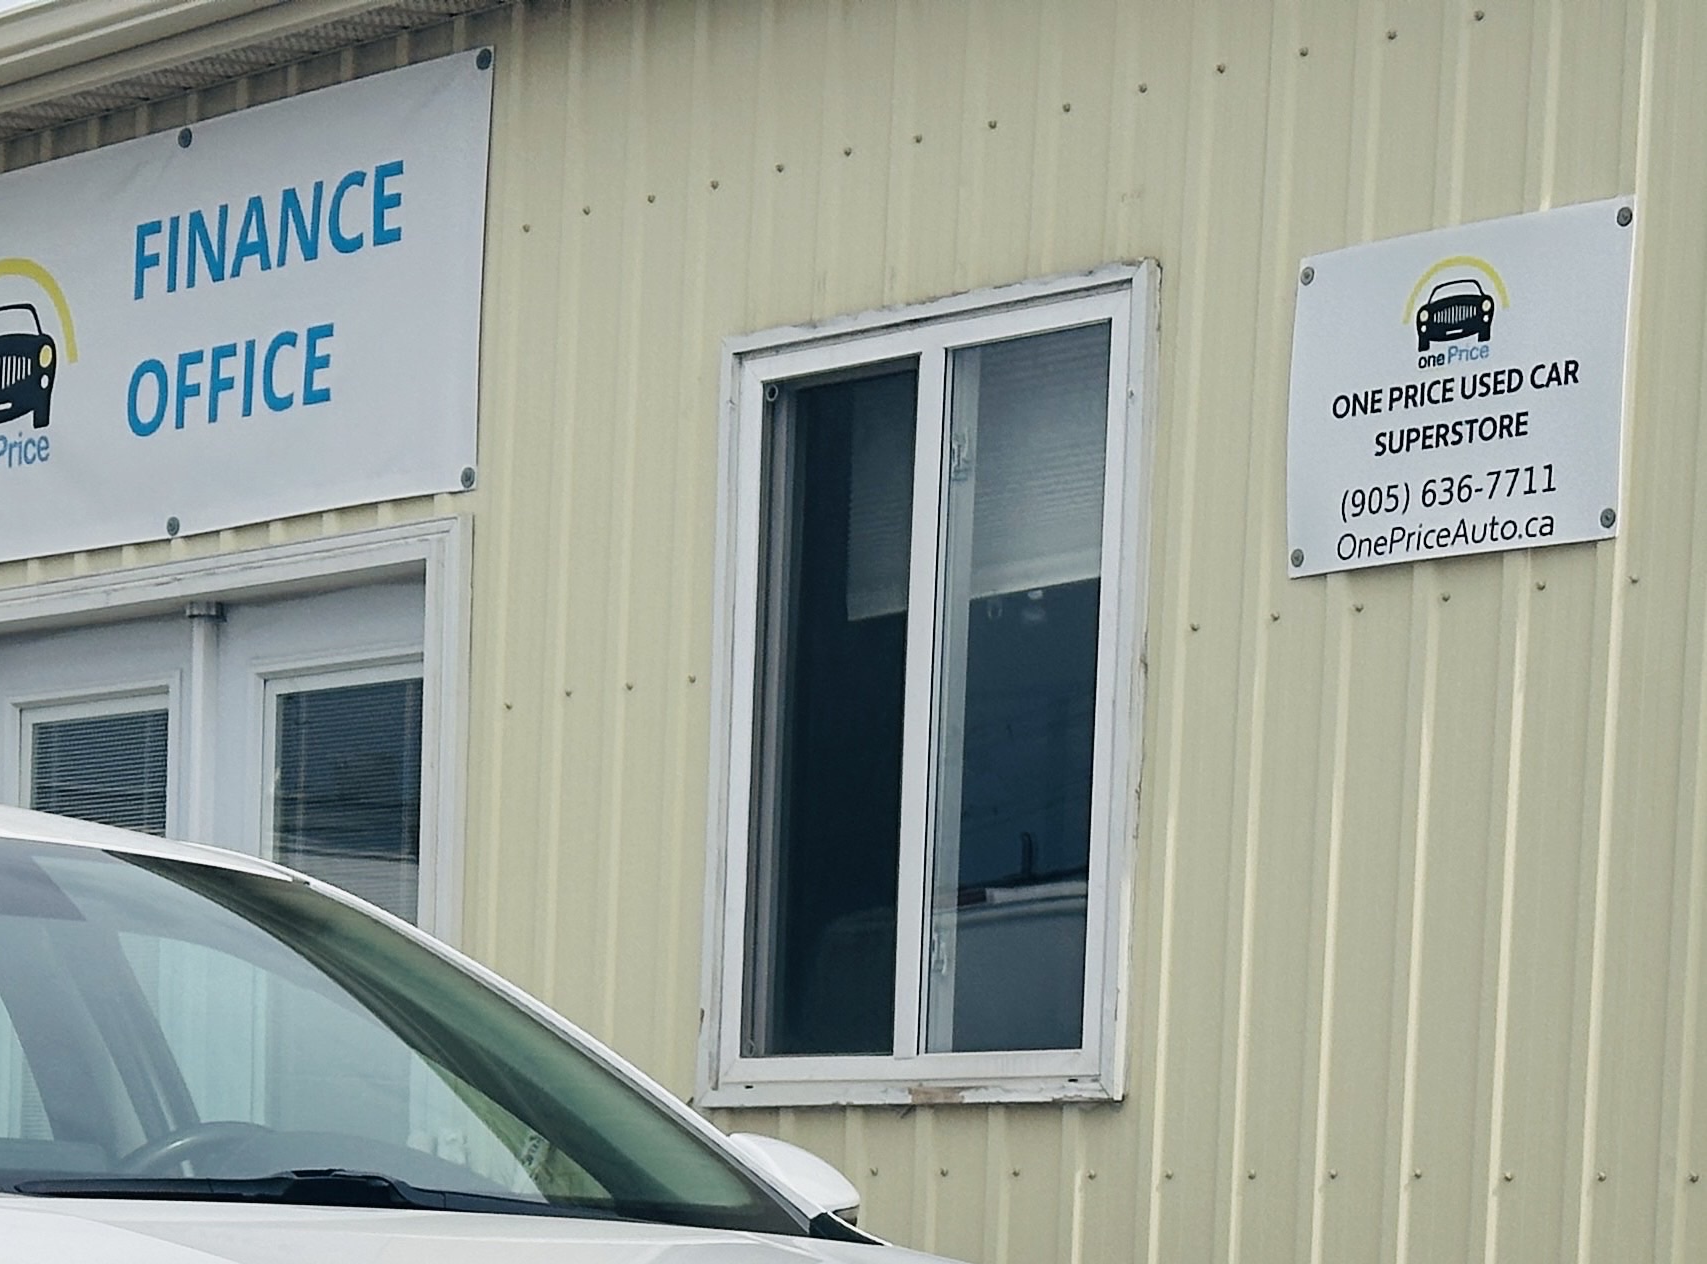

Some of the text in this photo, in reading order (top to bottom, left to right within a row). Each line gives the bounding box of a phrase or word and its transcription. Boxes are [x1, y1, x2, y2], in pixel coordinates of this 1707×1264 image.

[134, 160, 404, 300] FINANCE
[127, 322, 334, 437] OFFICE
[1418, 343, 1490, 370] one Price
[1333, 360, 1579, 419] ONE PRICE USED CAR
[1374, 411, 1529, 456] SUPERSTORE
[1342, 464, 1556, 523] (905) 636-7711
[1337, 516, 1554, 560] OnePriceAuto.ca
